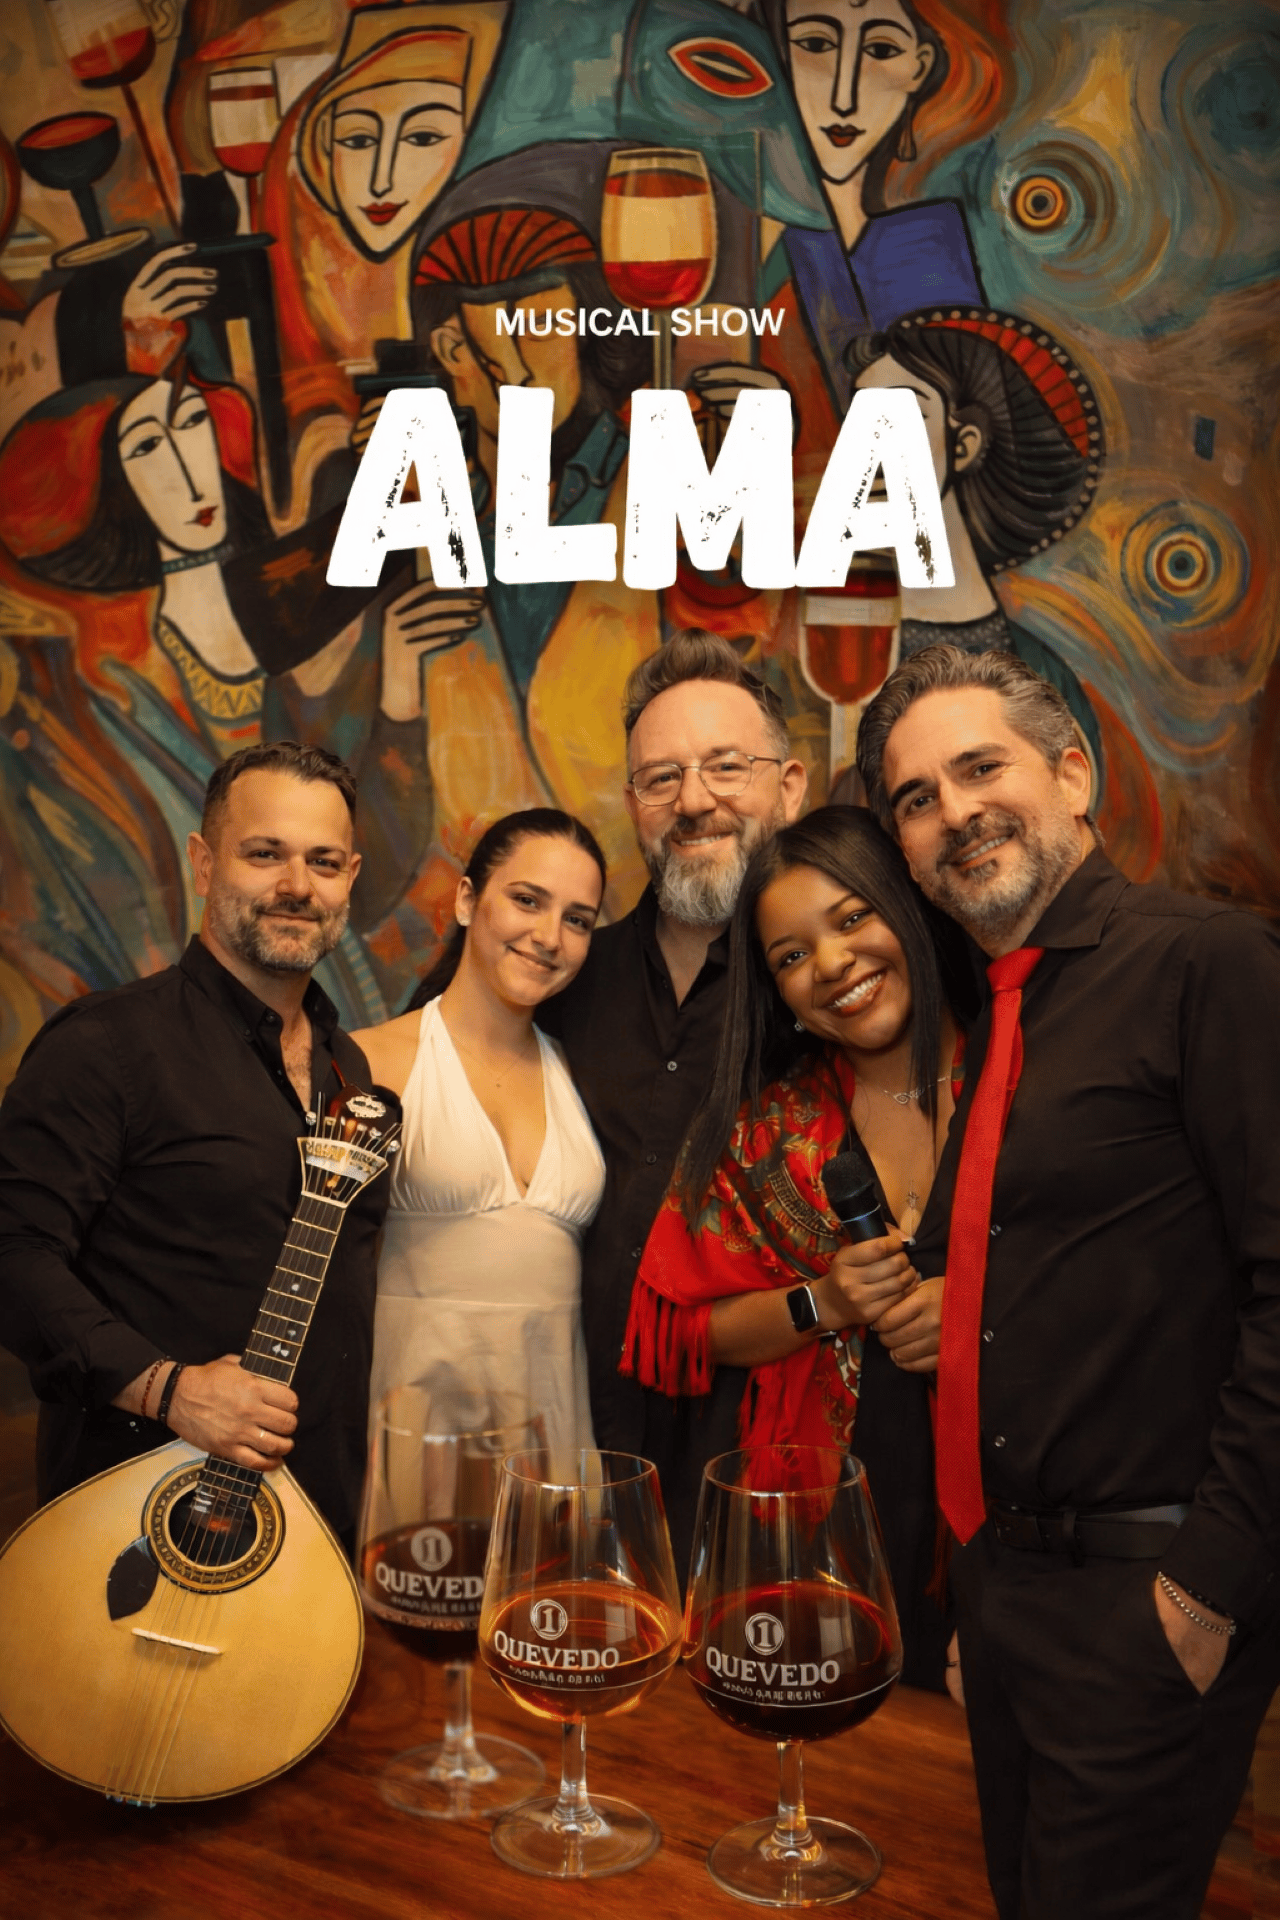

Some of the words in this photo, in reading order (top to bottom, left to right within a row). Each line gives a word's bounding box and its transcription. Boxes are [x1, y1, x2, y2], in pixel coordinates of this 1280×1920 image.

[375, 1562, 485, 1599] QUEVED
[494, 1630, 621, 1671] QUEVEDO
[705, 1646, 841, 1687] QUEVEDO
